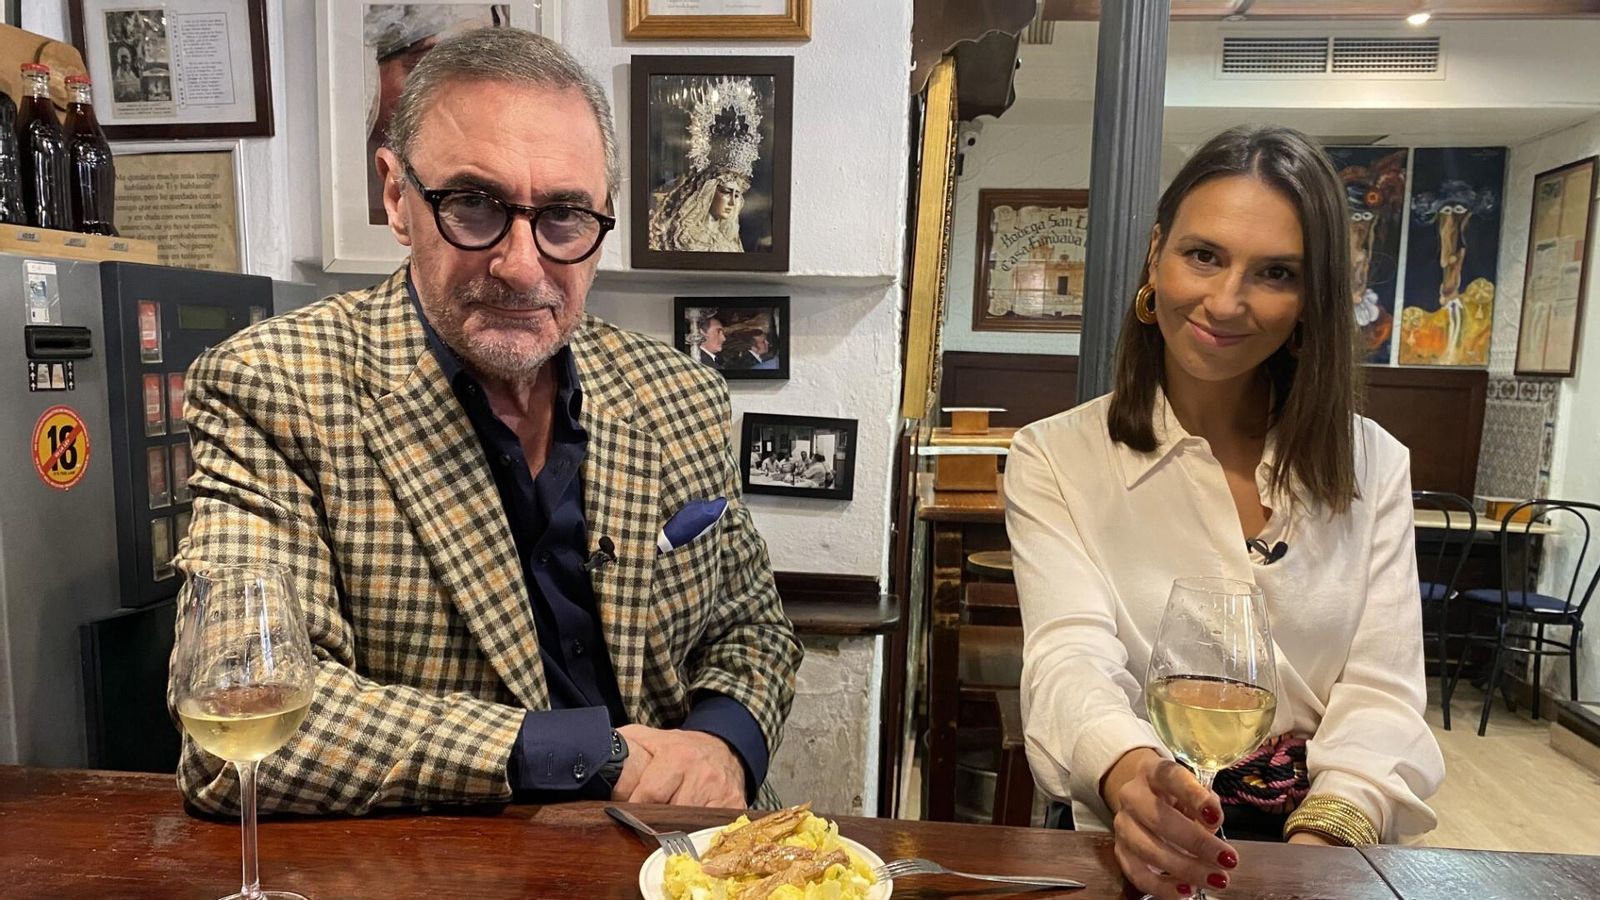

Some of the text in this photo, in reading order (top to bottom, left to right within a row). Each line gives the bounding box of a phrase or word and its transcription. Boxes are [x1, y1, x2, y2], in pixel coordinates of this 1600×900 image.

[1000, 221, 1046, 248] Bodega
[1048, 214, 1072, 228] San
[1002, 230, 1082, 272] Casa Fundada
[48, 424, 78, 472] 18
